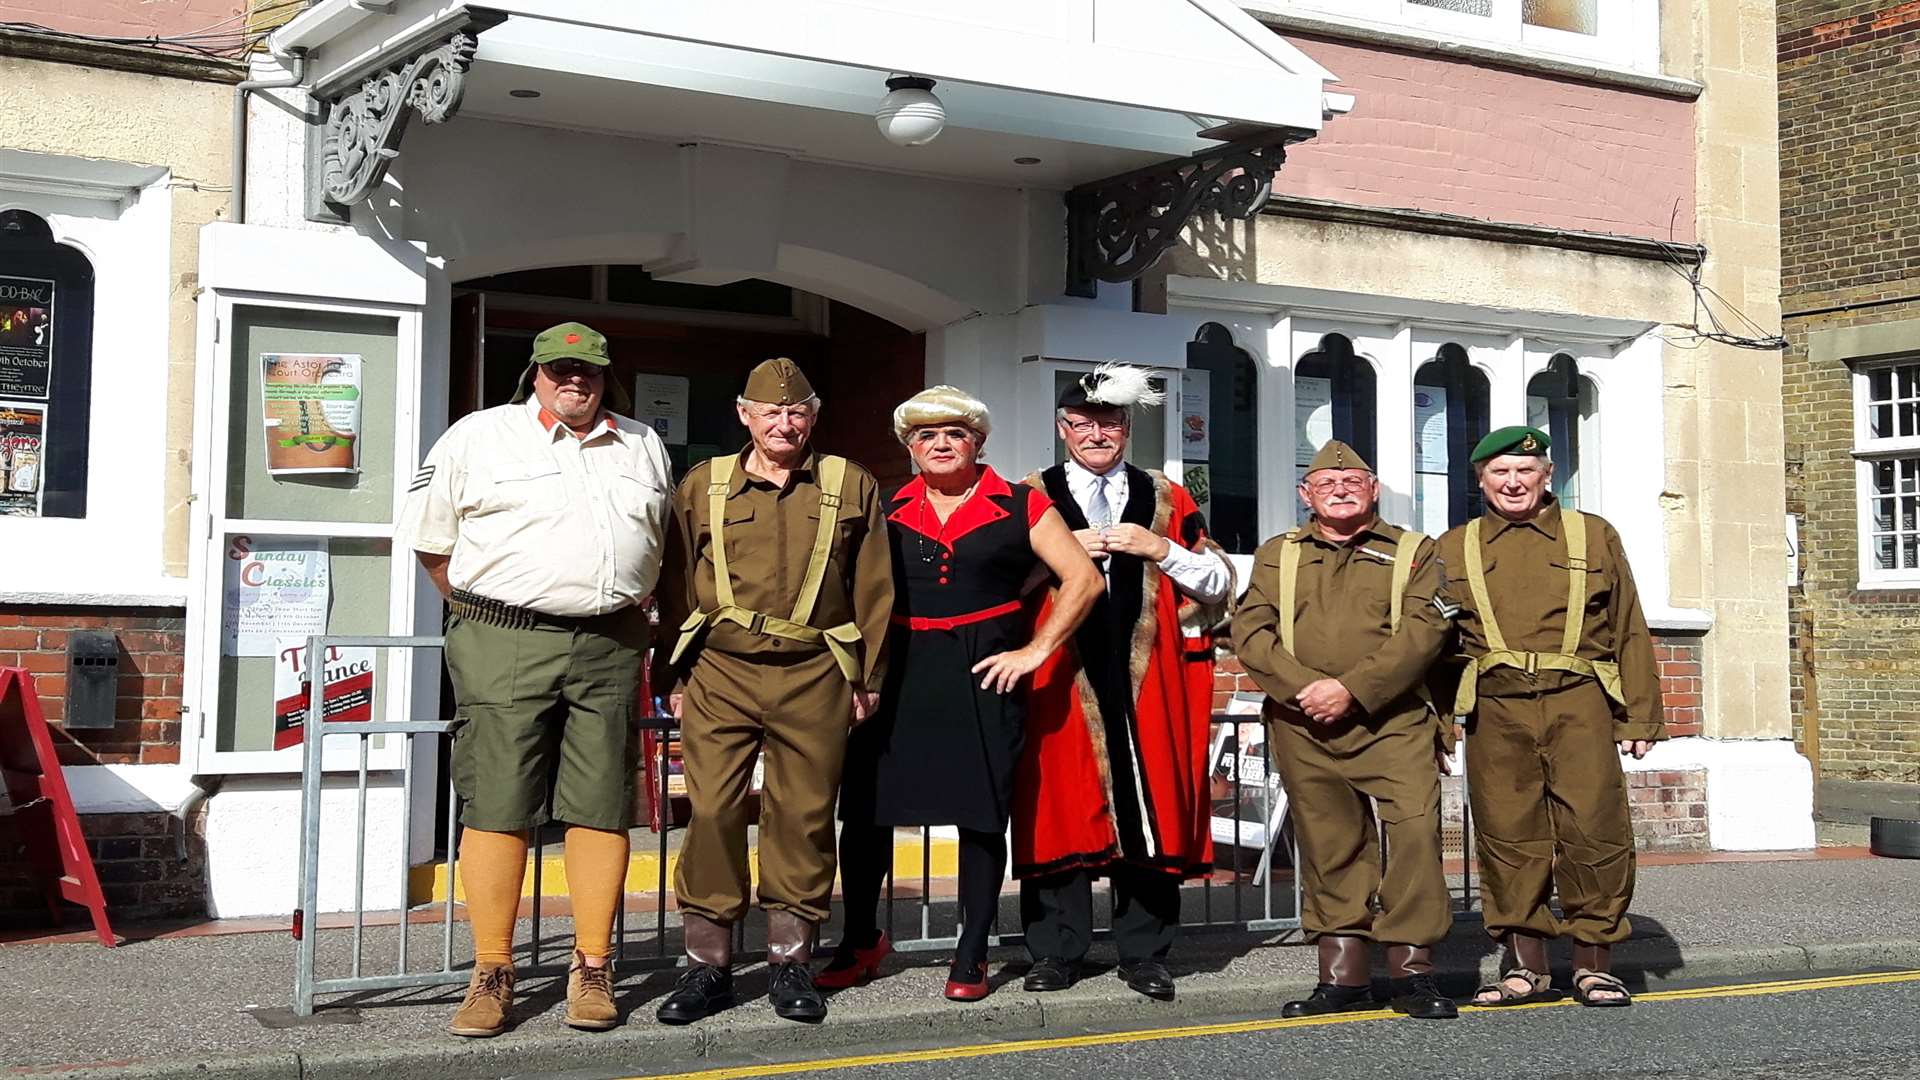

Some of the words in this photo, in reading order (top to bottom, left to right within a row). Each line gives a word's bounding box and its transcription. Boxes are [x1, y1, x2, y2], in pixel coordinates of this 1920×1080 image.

[12, 357, 48, 368] October
[294, 360, 322, 369] Astor
[302, 369, 353, 378] Orcestra
[228, 535, 306, 565] Sunday
[242, 562, 326, 587] Classics
[281, 645, 343, 673] Ta
[298, 659, 371, 683] ance
